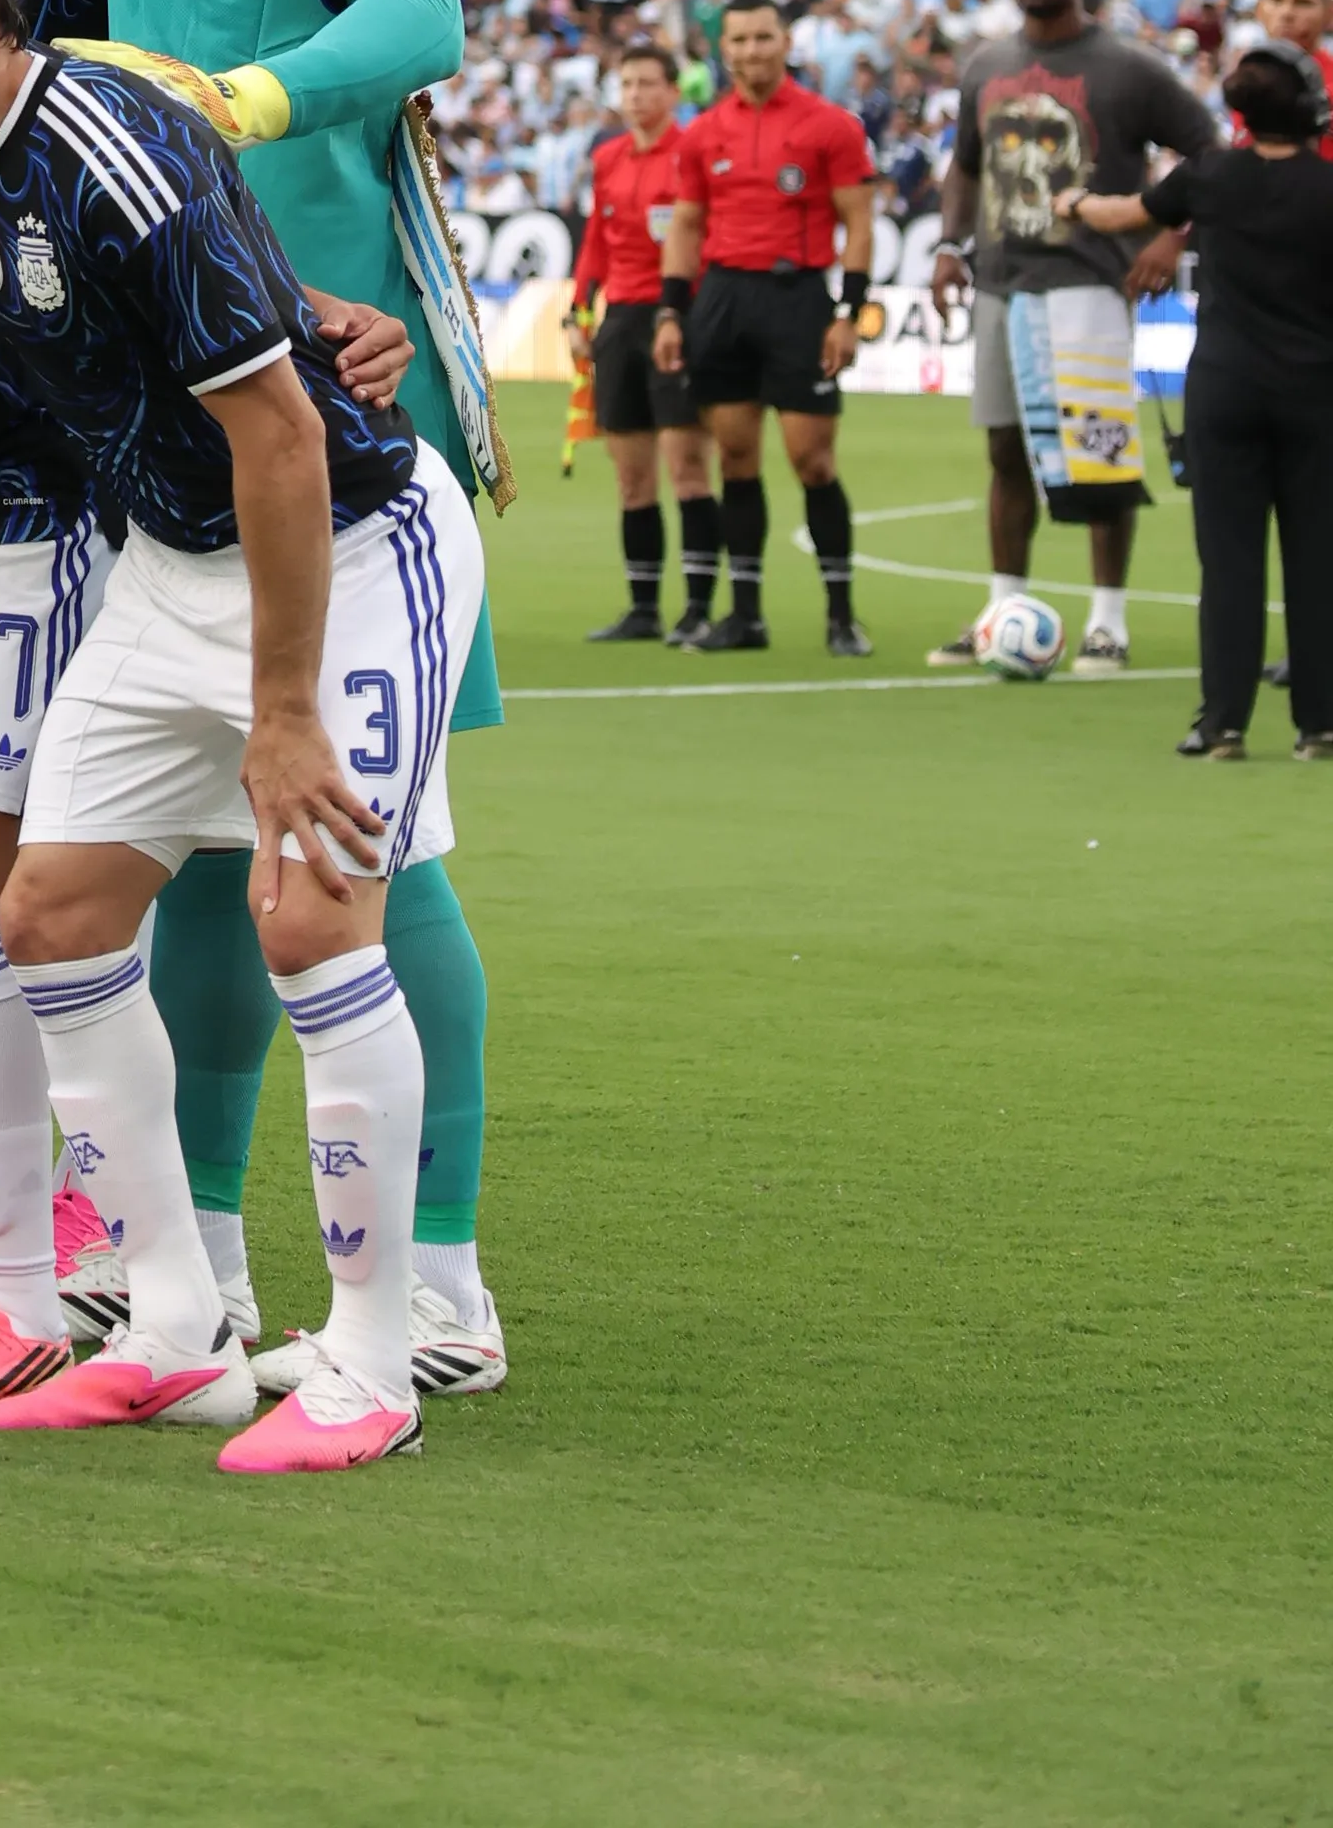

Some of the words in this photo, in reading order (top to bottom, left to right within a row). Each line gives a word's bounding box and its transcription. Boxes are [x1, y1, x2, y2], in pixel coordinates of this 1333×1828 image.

[26, 258, 51, 289] AFA
[855, 301, 972, 345] OAD
[344, 669, 401, 779] 3
